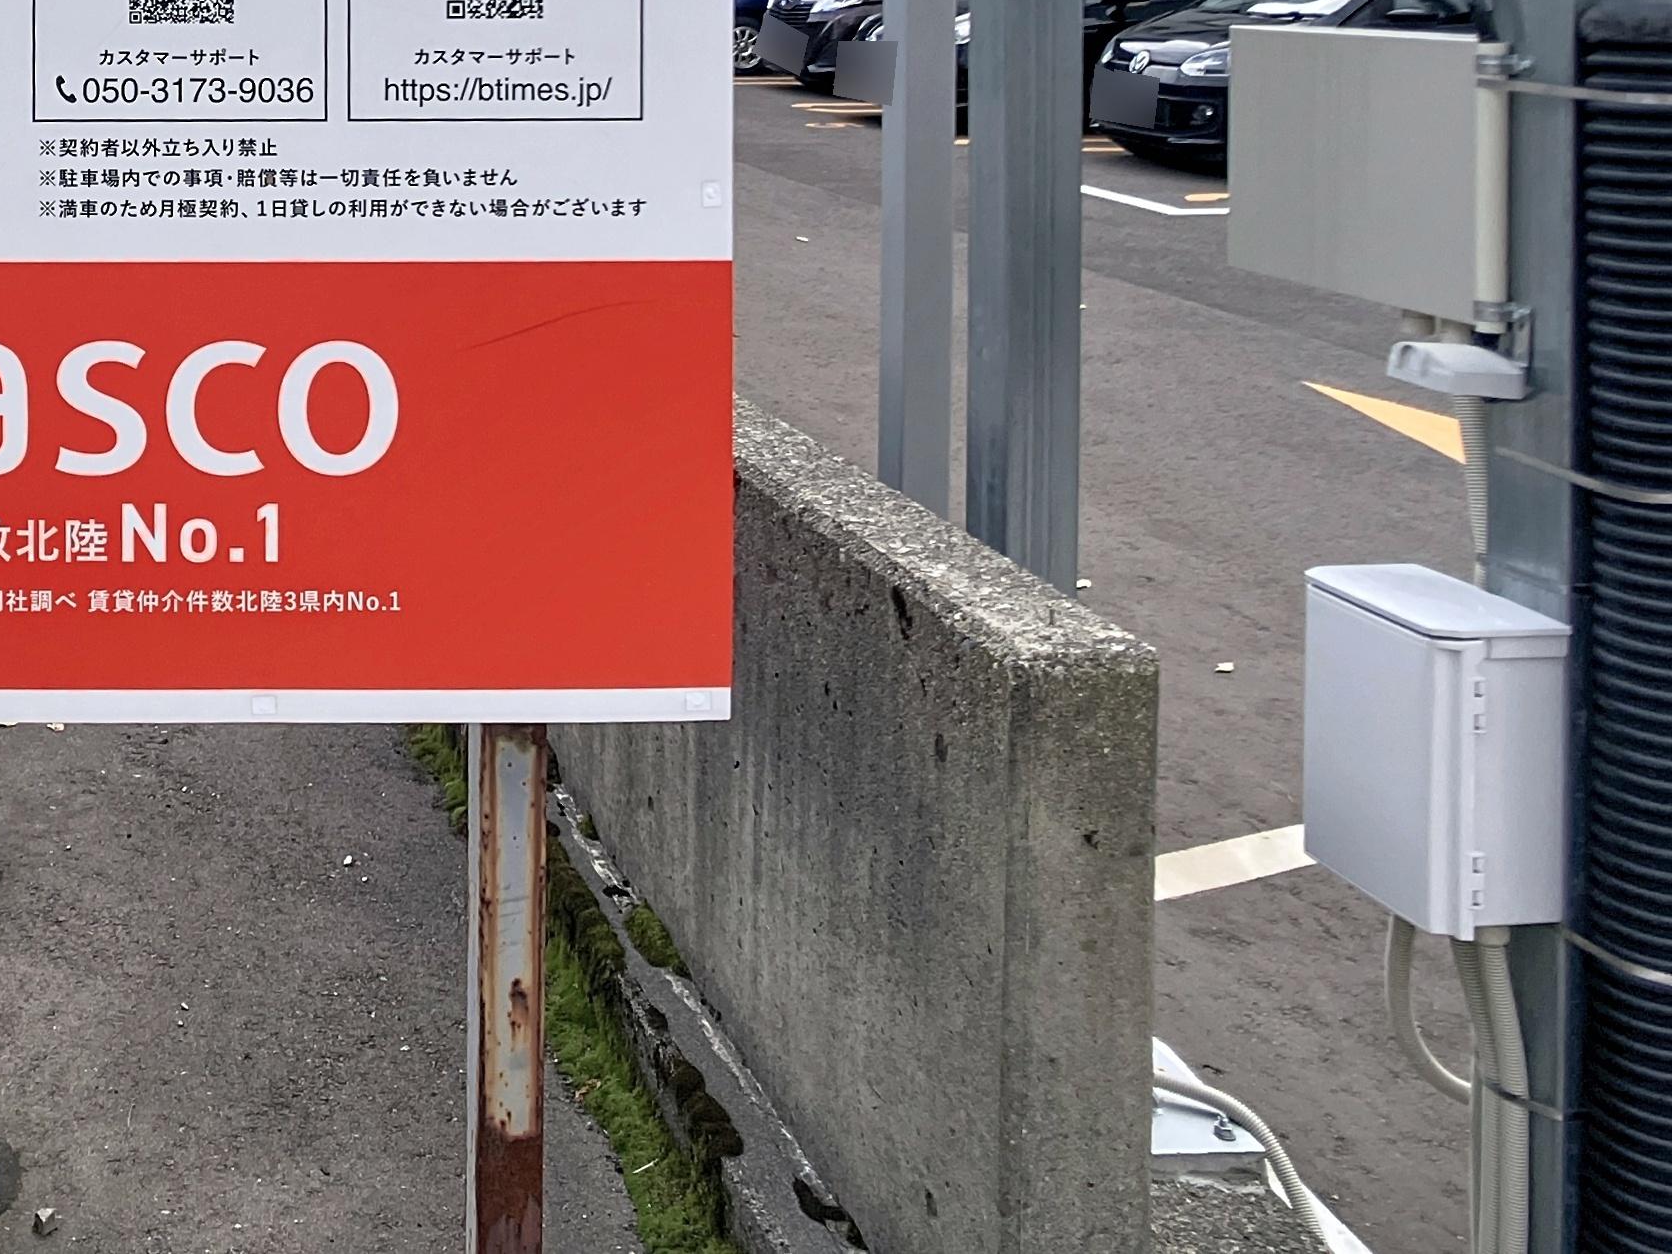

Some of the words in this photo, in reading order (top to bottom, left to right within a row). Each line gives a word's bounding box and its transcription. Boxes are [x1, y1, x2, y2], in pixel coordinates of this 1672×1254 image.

[99, 49, 261, 67] カスタマーサポート
[414, 48, 576, 67] カスタマーサポート
[82, 76, 315, 105] 050-3173-9036
[384, 76, 613, 108] https://btimes.jp/
[39, 138, 278, 158] ※契約者以外立ち入り禁止
[86, 588, 402, 613] 賃貸仲介件数北陸3県内No.1
